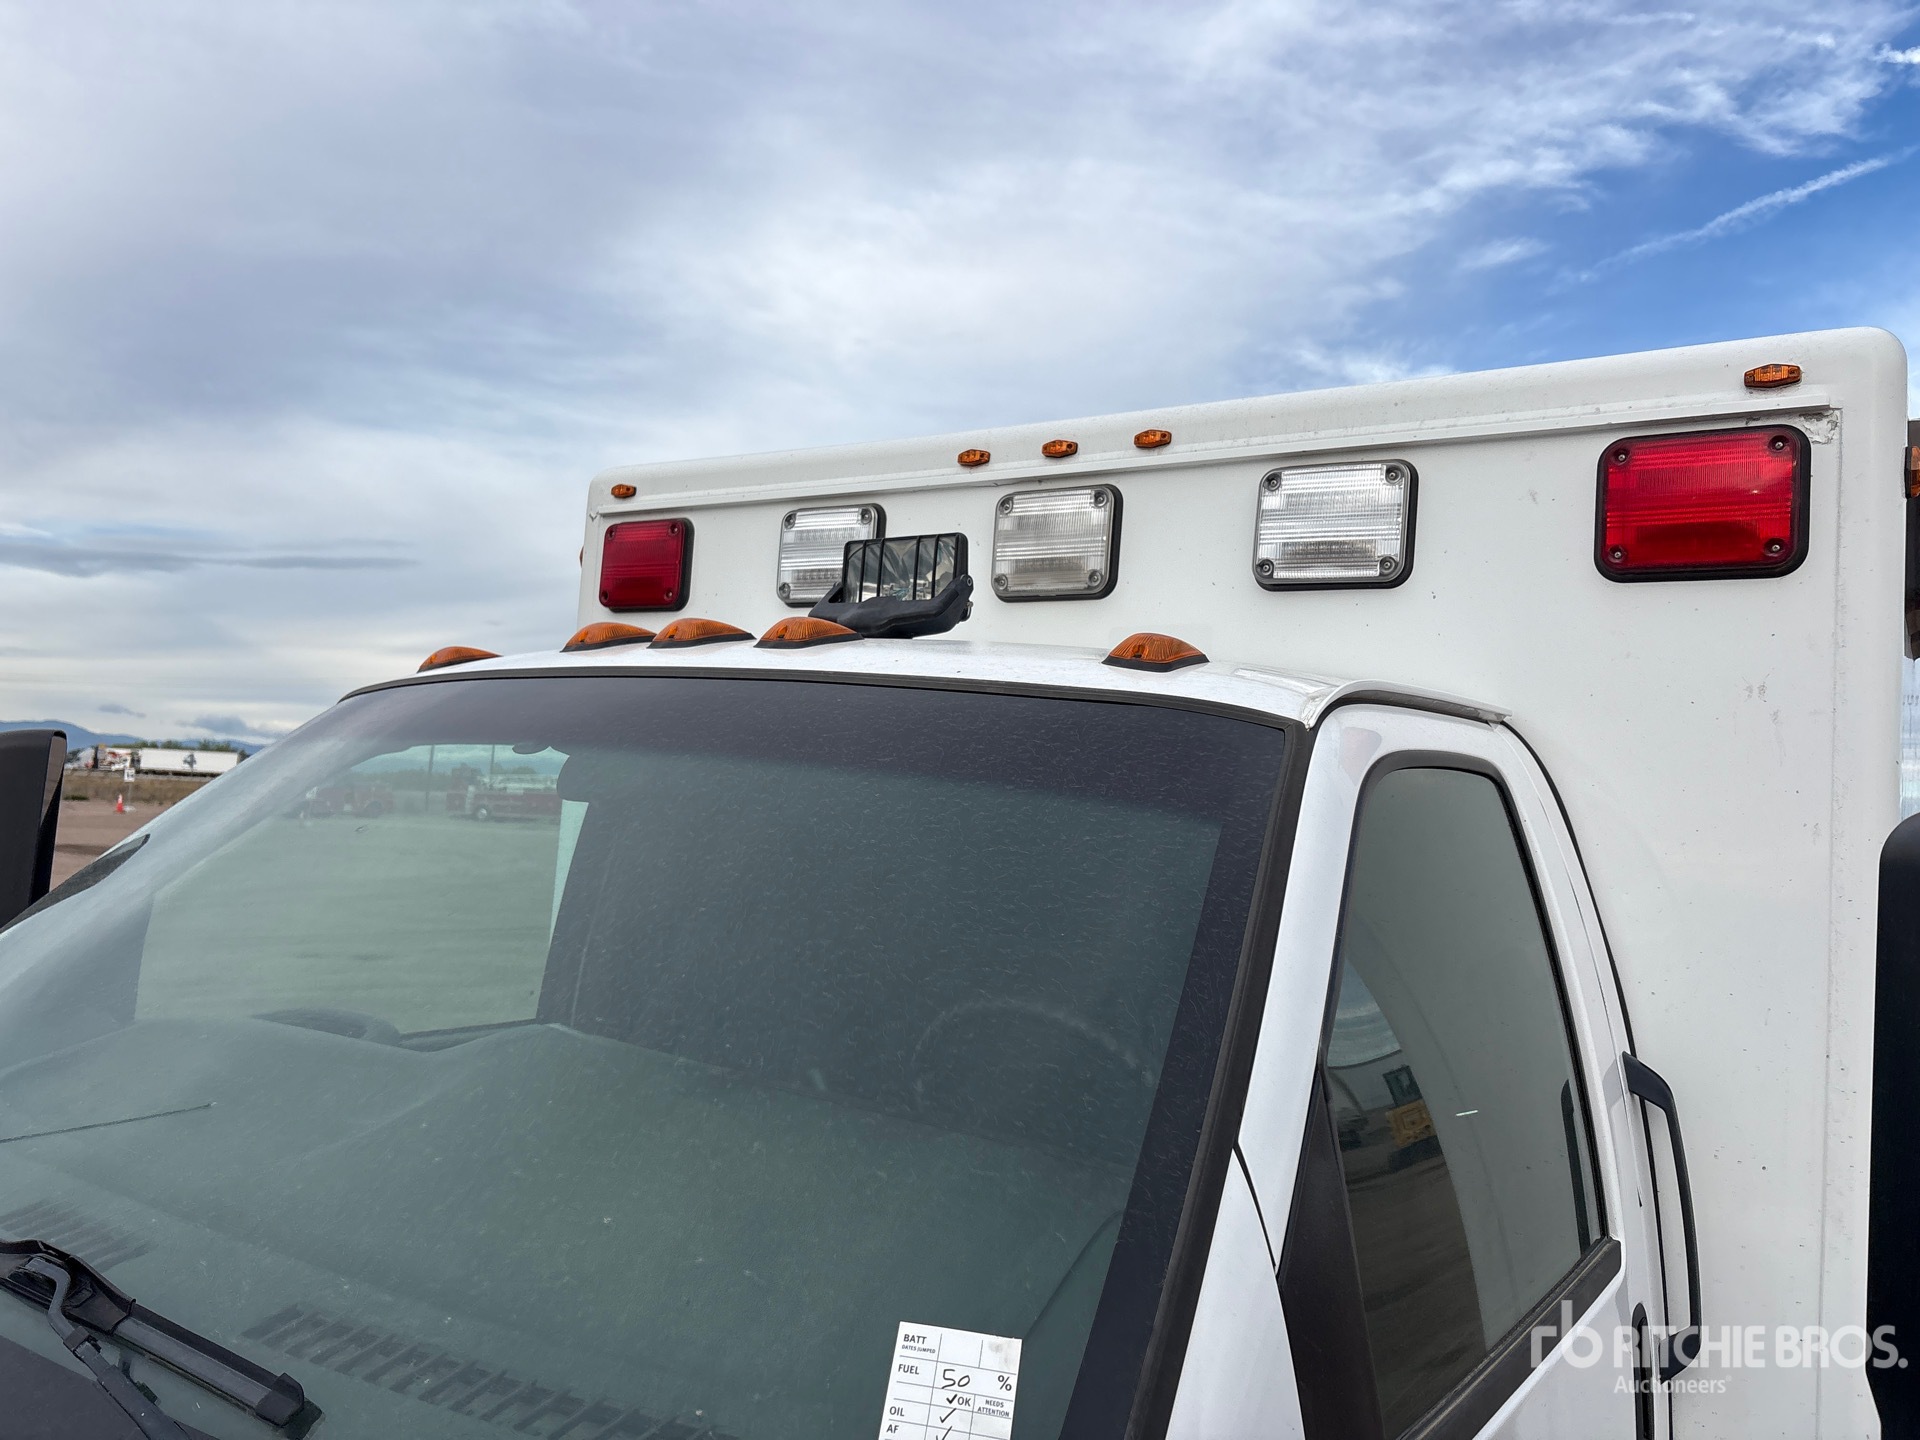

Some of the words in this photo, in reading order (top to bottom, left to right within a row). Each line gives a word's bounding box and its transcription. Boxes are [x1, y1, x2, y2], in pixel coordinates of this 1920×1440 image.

[903, 1333, 927, 1345] BATT
[901, 1344, 917, 1352] DATES
[917, 1346, 936, 1354] JUMPED
[898, 1363, 920, 1375] FUEL
[941, 1368, 971, 1389] 50
[997, 1375, 1012, 1391] %
[957, 1396, 971, 1407] OK
[985, 1399, 1004, 1408] NEEDS
[889, 1406, 905, 1417] OIL
[977, 1406, 1010, 1417] ATTENTION
[886, 1424, 899, 1434] AF
